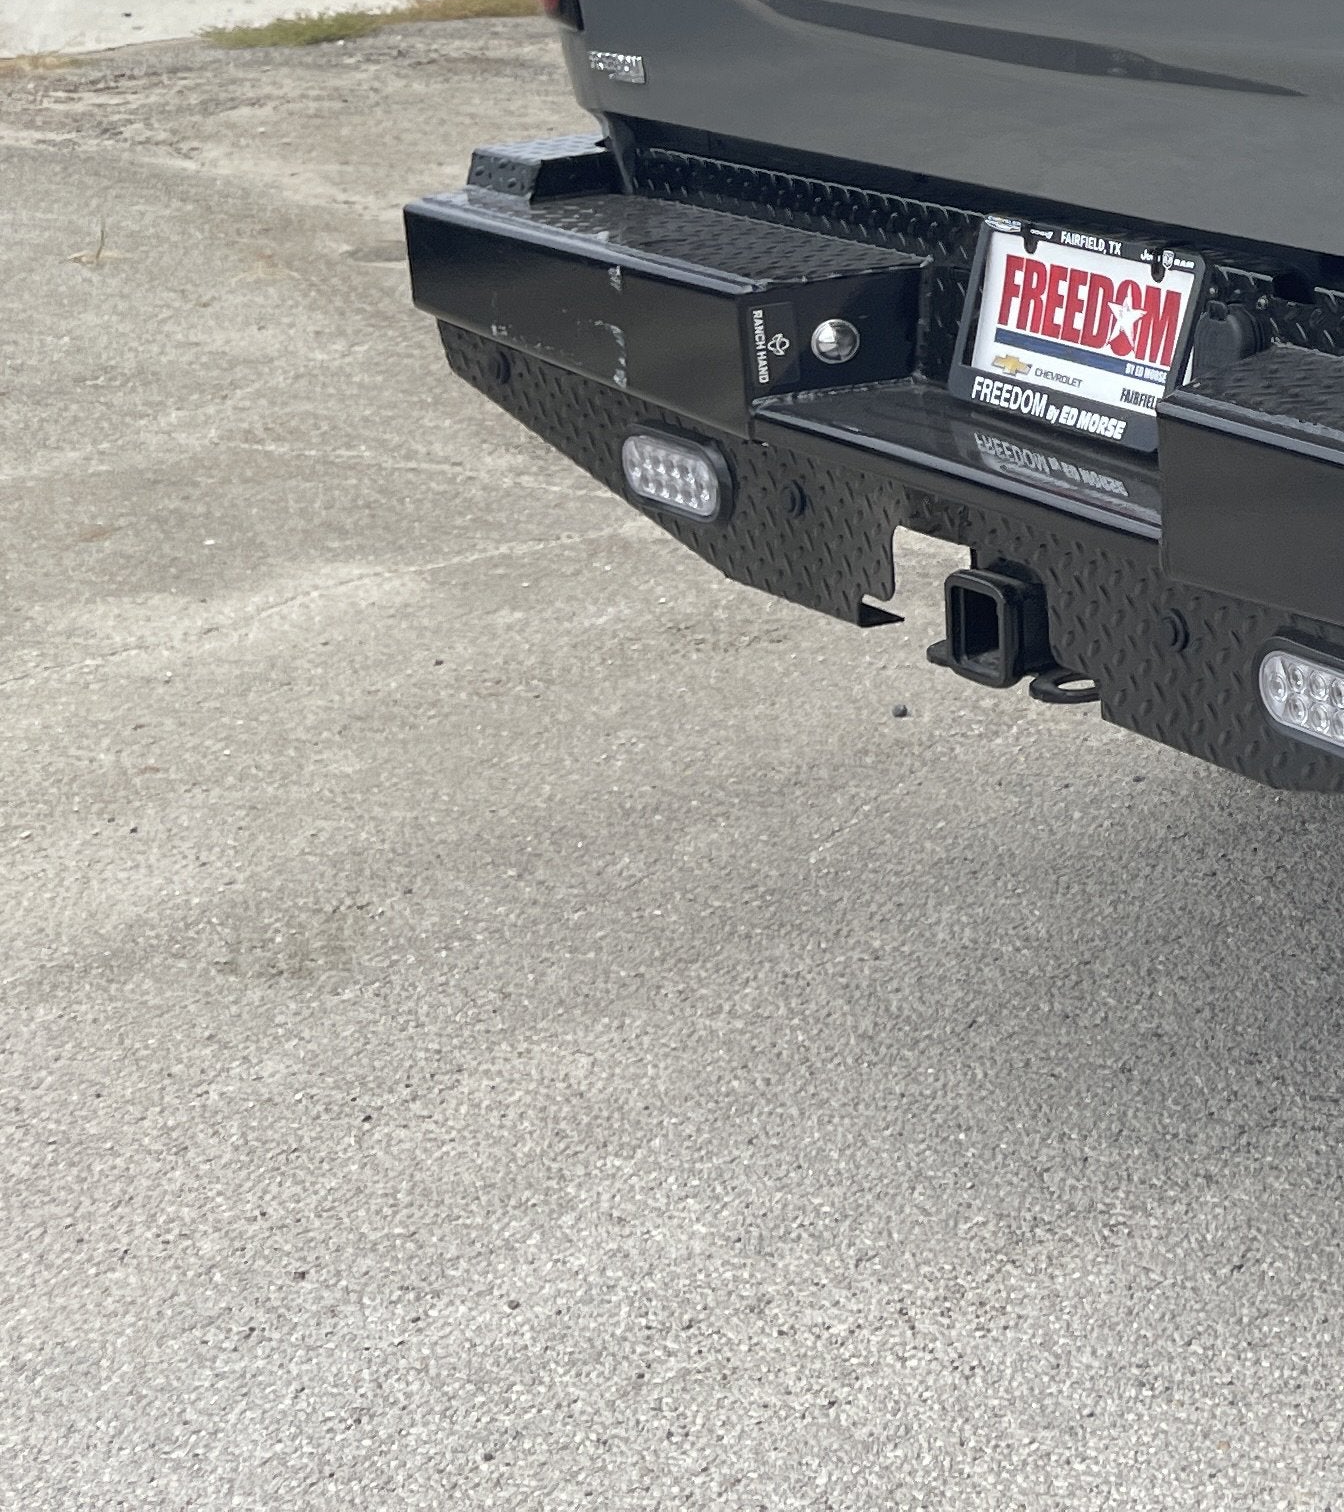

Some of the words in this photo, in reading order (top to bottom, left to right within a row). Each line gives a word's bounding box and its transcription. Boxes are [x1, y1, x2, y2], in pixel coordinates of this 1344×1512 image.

[1060, 230, 1107, 255] FAIRFIELD,
[1108, 241, 1122, 256] TX
[997, 253, 1182, 367] FREEDOM
[752, 309, 767, 350] RANCH
[757, 351, 770, 384] HAND
[1034, 367, 1083, 388] CHEVROLET
[971, 375, 1049, 419] FREEDOM
[1059, 405, 1080, 427] ED
[1076, 410, 1128, 440] MORSE
[1120, 387, 1156, 410] FAIRFIEL
